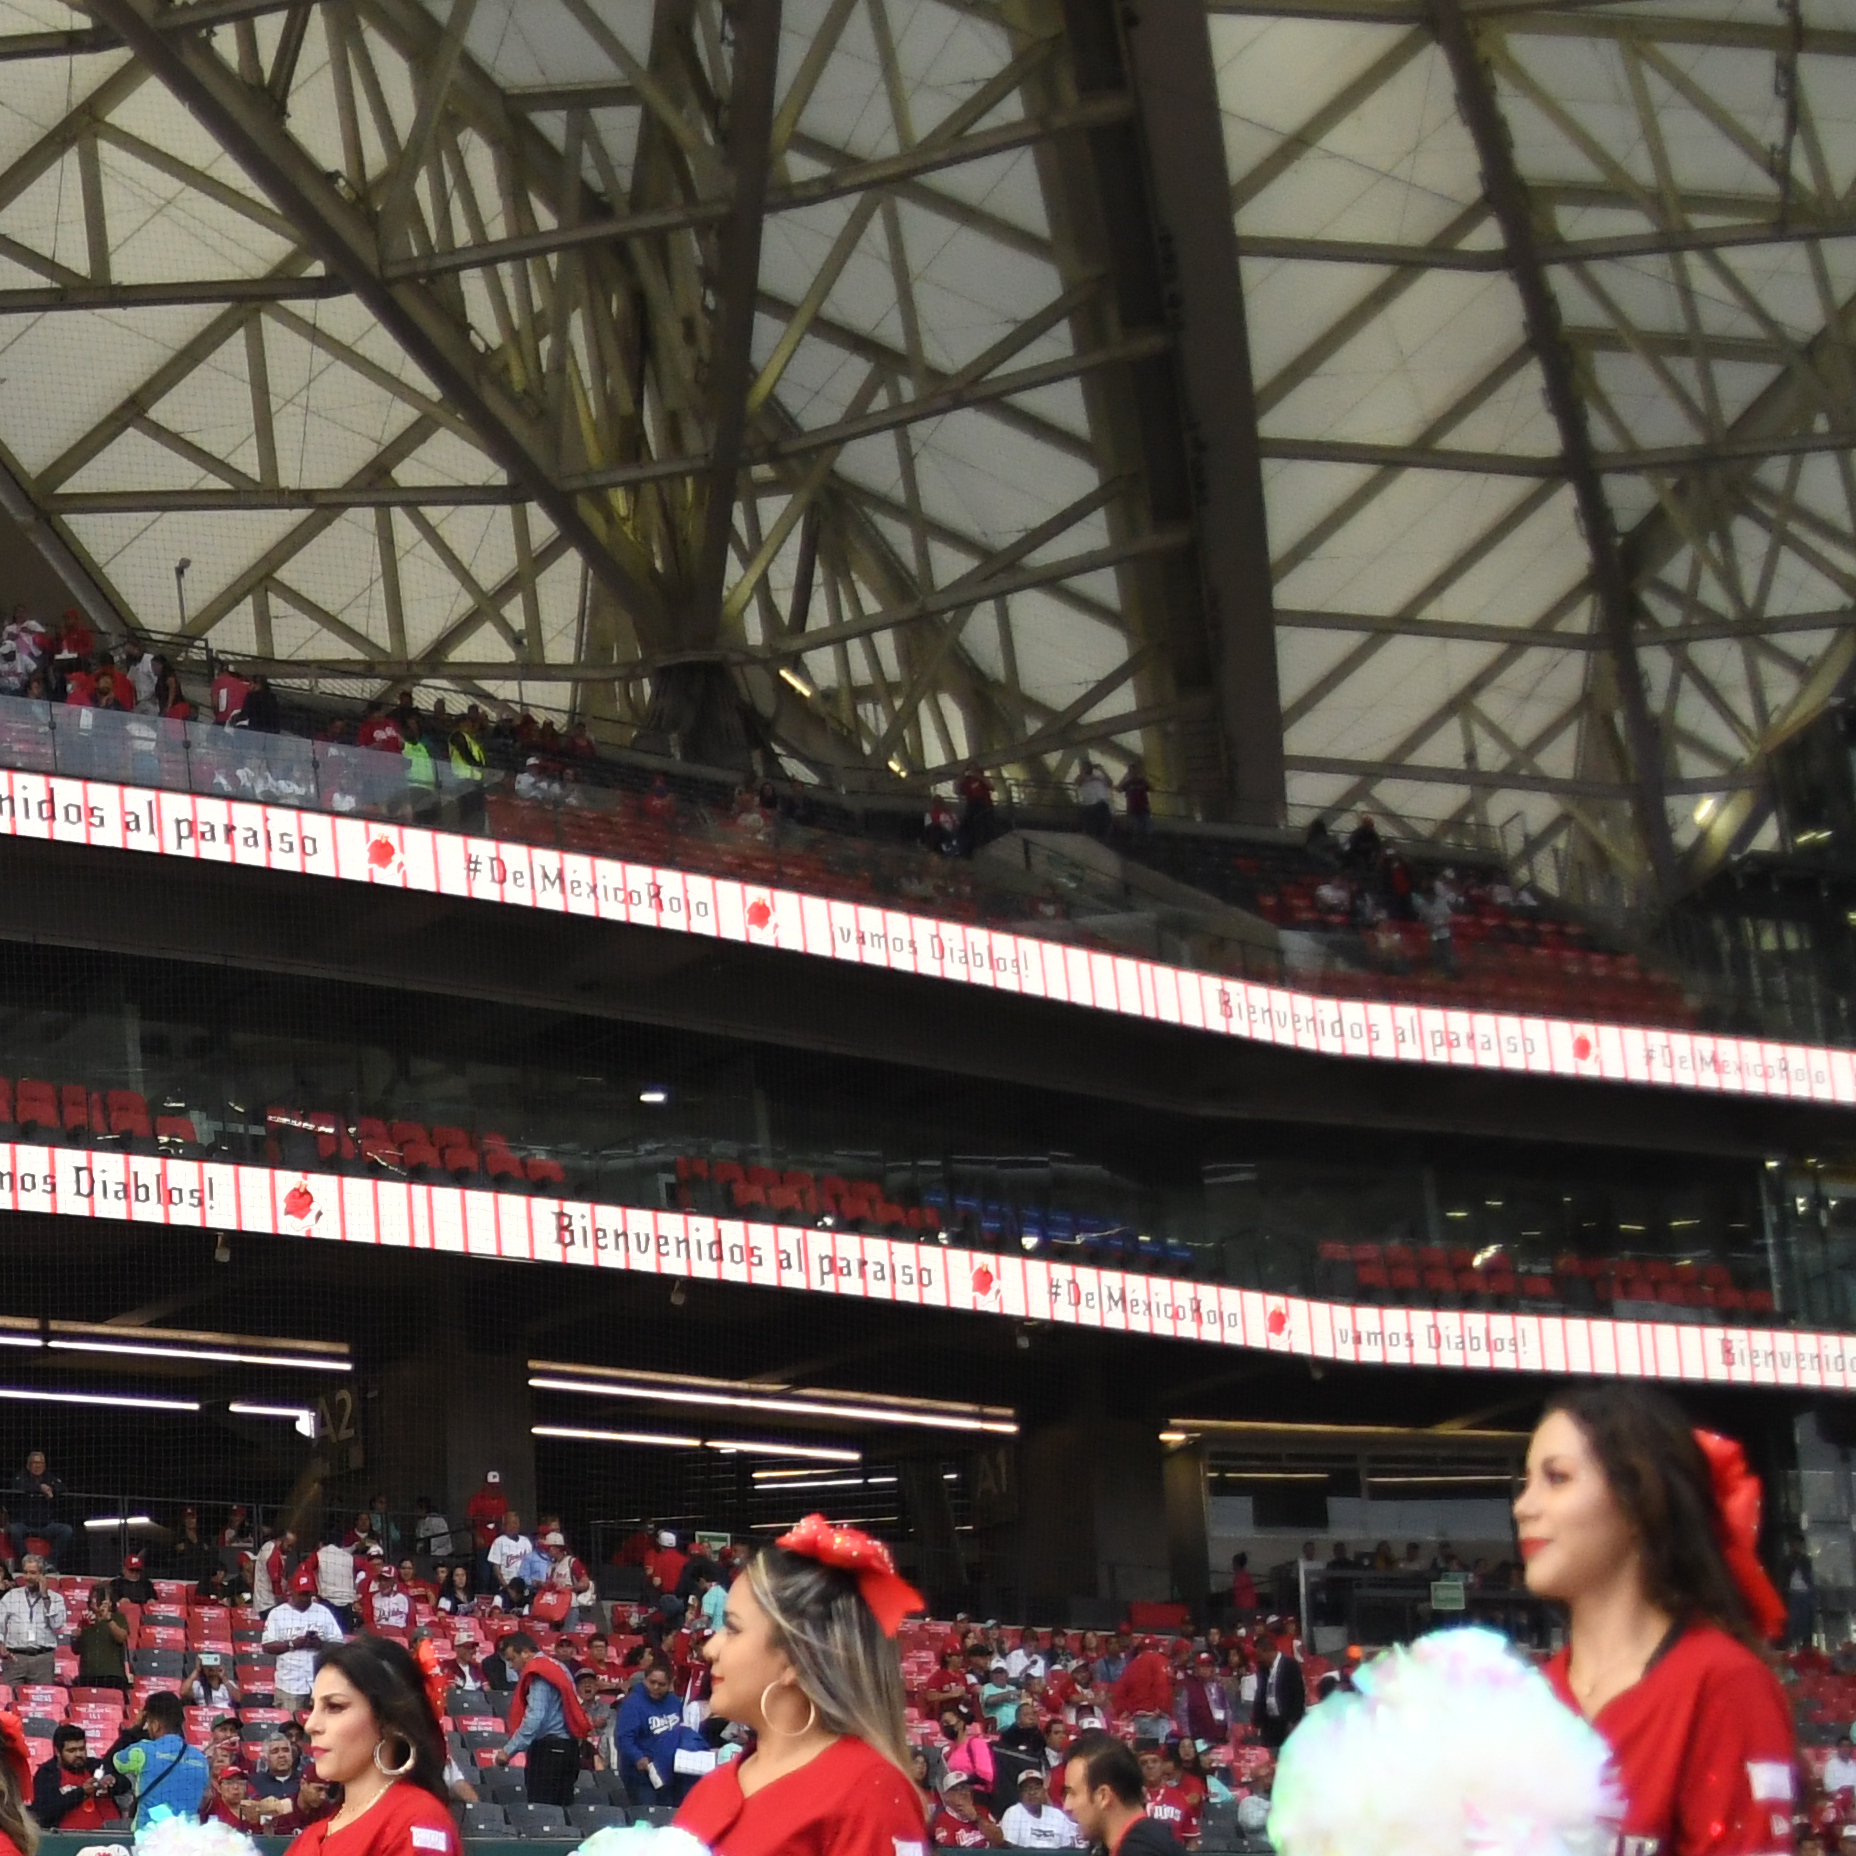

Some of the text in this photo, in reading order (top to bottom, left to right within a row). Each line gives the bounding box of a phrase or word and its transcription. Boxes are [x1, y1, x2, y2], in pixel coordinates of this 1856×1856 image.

[124, 799, 157, 838] al
[464, 853, 710, 920] #DelMéxicoRojo
[929, 933, 1030, 977] Diablos!
[1217, 988, 1382, 1042] Bienvenidos
[1395, 1015, 1417, 1046] al
[72, 1165, 215, 1210] Diablos!
[551, 1208, 764, 1267] Bienvenidos
[778, 1238, 803, 1273] al
[1426, 1324, 1529, 1355] Diablos!
